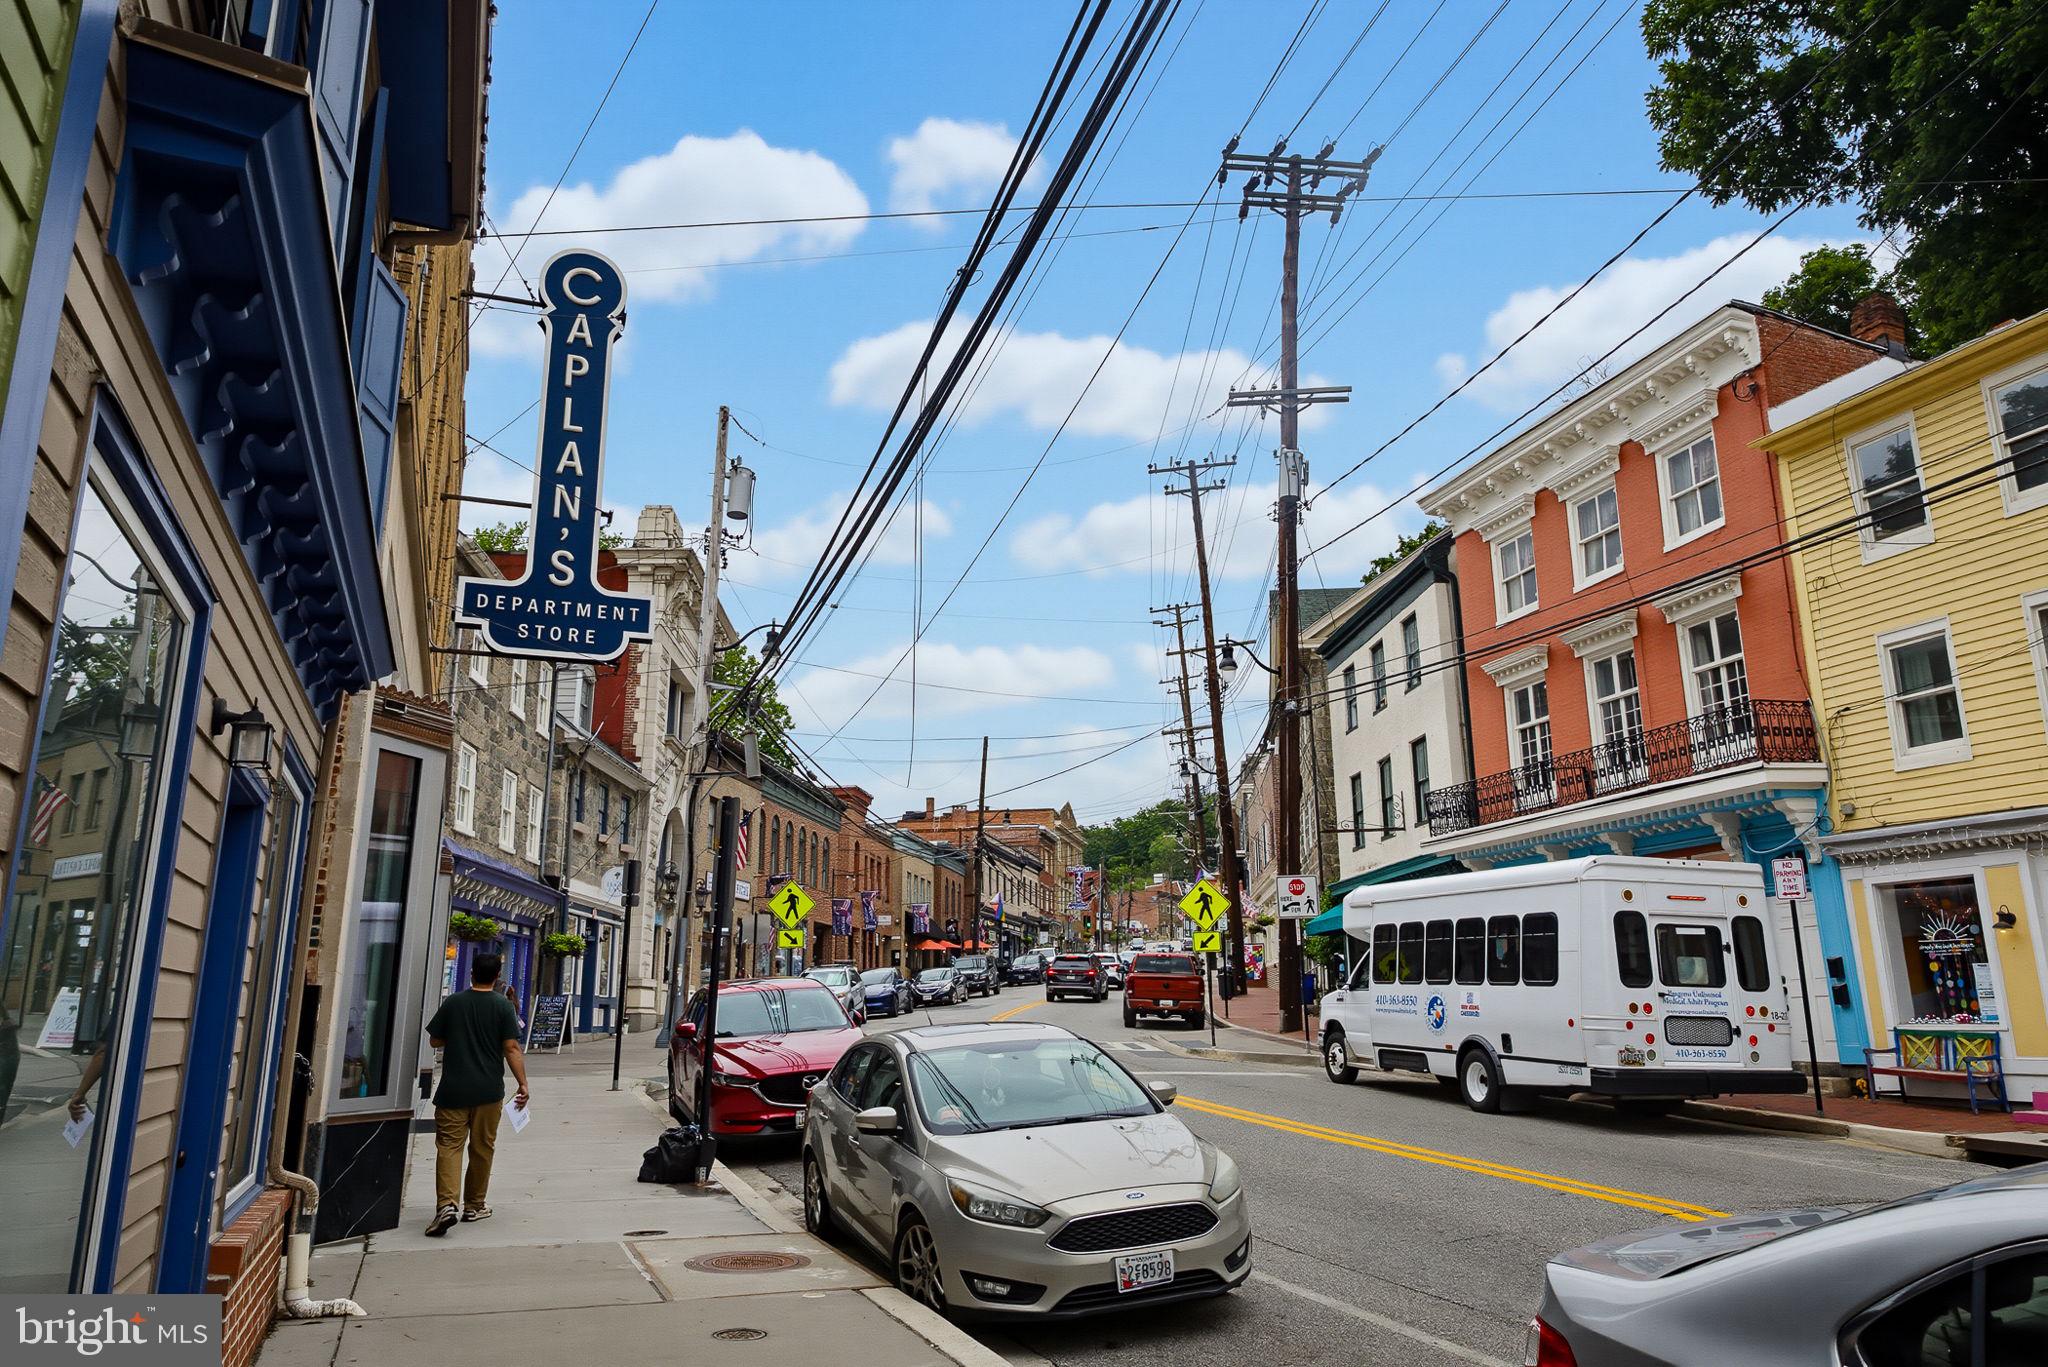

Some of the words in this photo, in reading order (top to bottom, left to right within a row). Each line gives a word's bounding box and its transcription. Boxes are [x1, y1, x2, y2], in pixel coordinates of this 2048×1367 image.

[548, 267, 603, 587] CAPLAN'S
[476, 593, 640, 622] DEPARTMENT
[517, 623, 597, 645] STORE
[1289, 883, 1305, 891] STOP
[1375, 994, 1418, 1007] 410-363-8550
[1675, 1049, 1727, 1058] 410-363-8550
